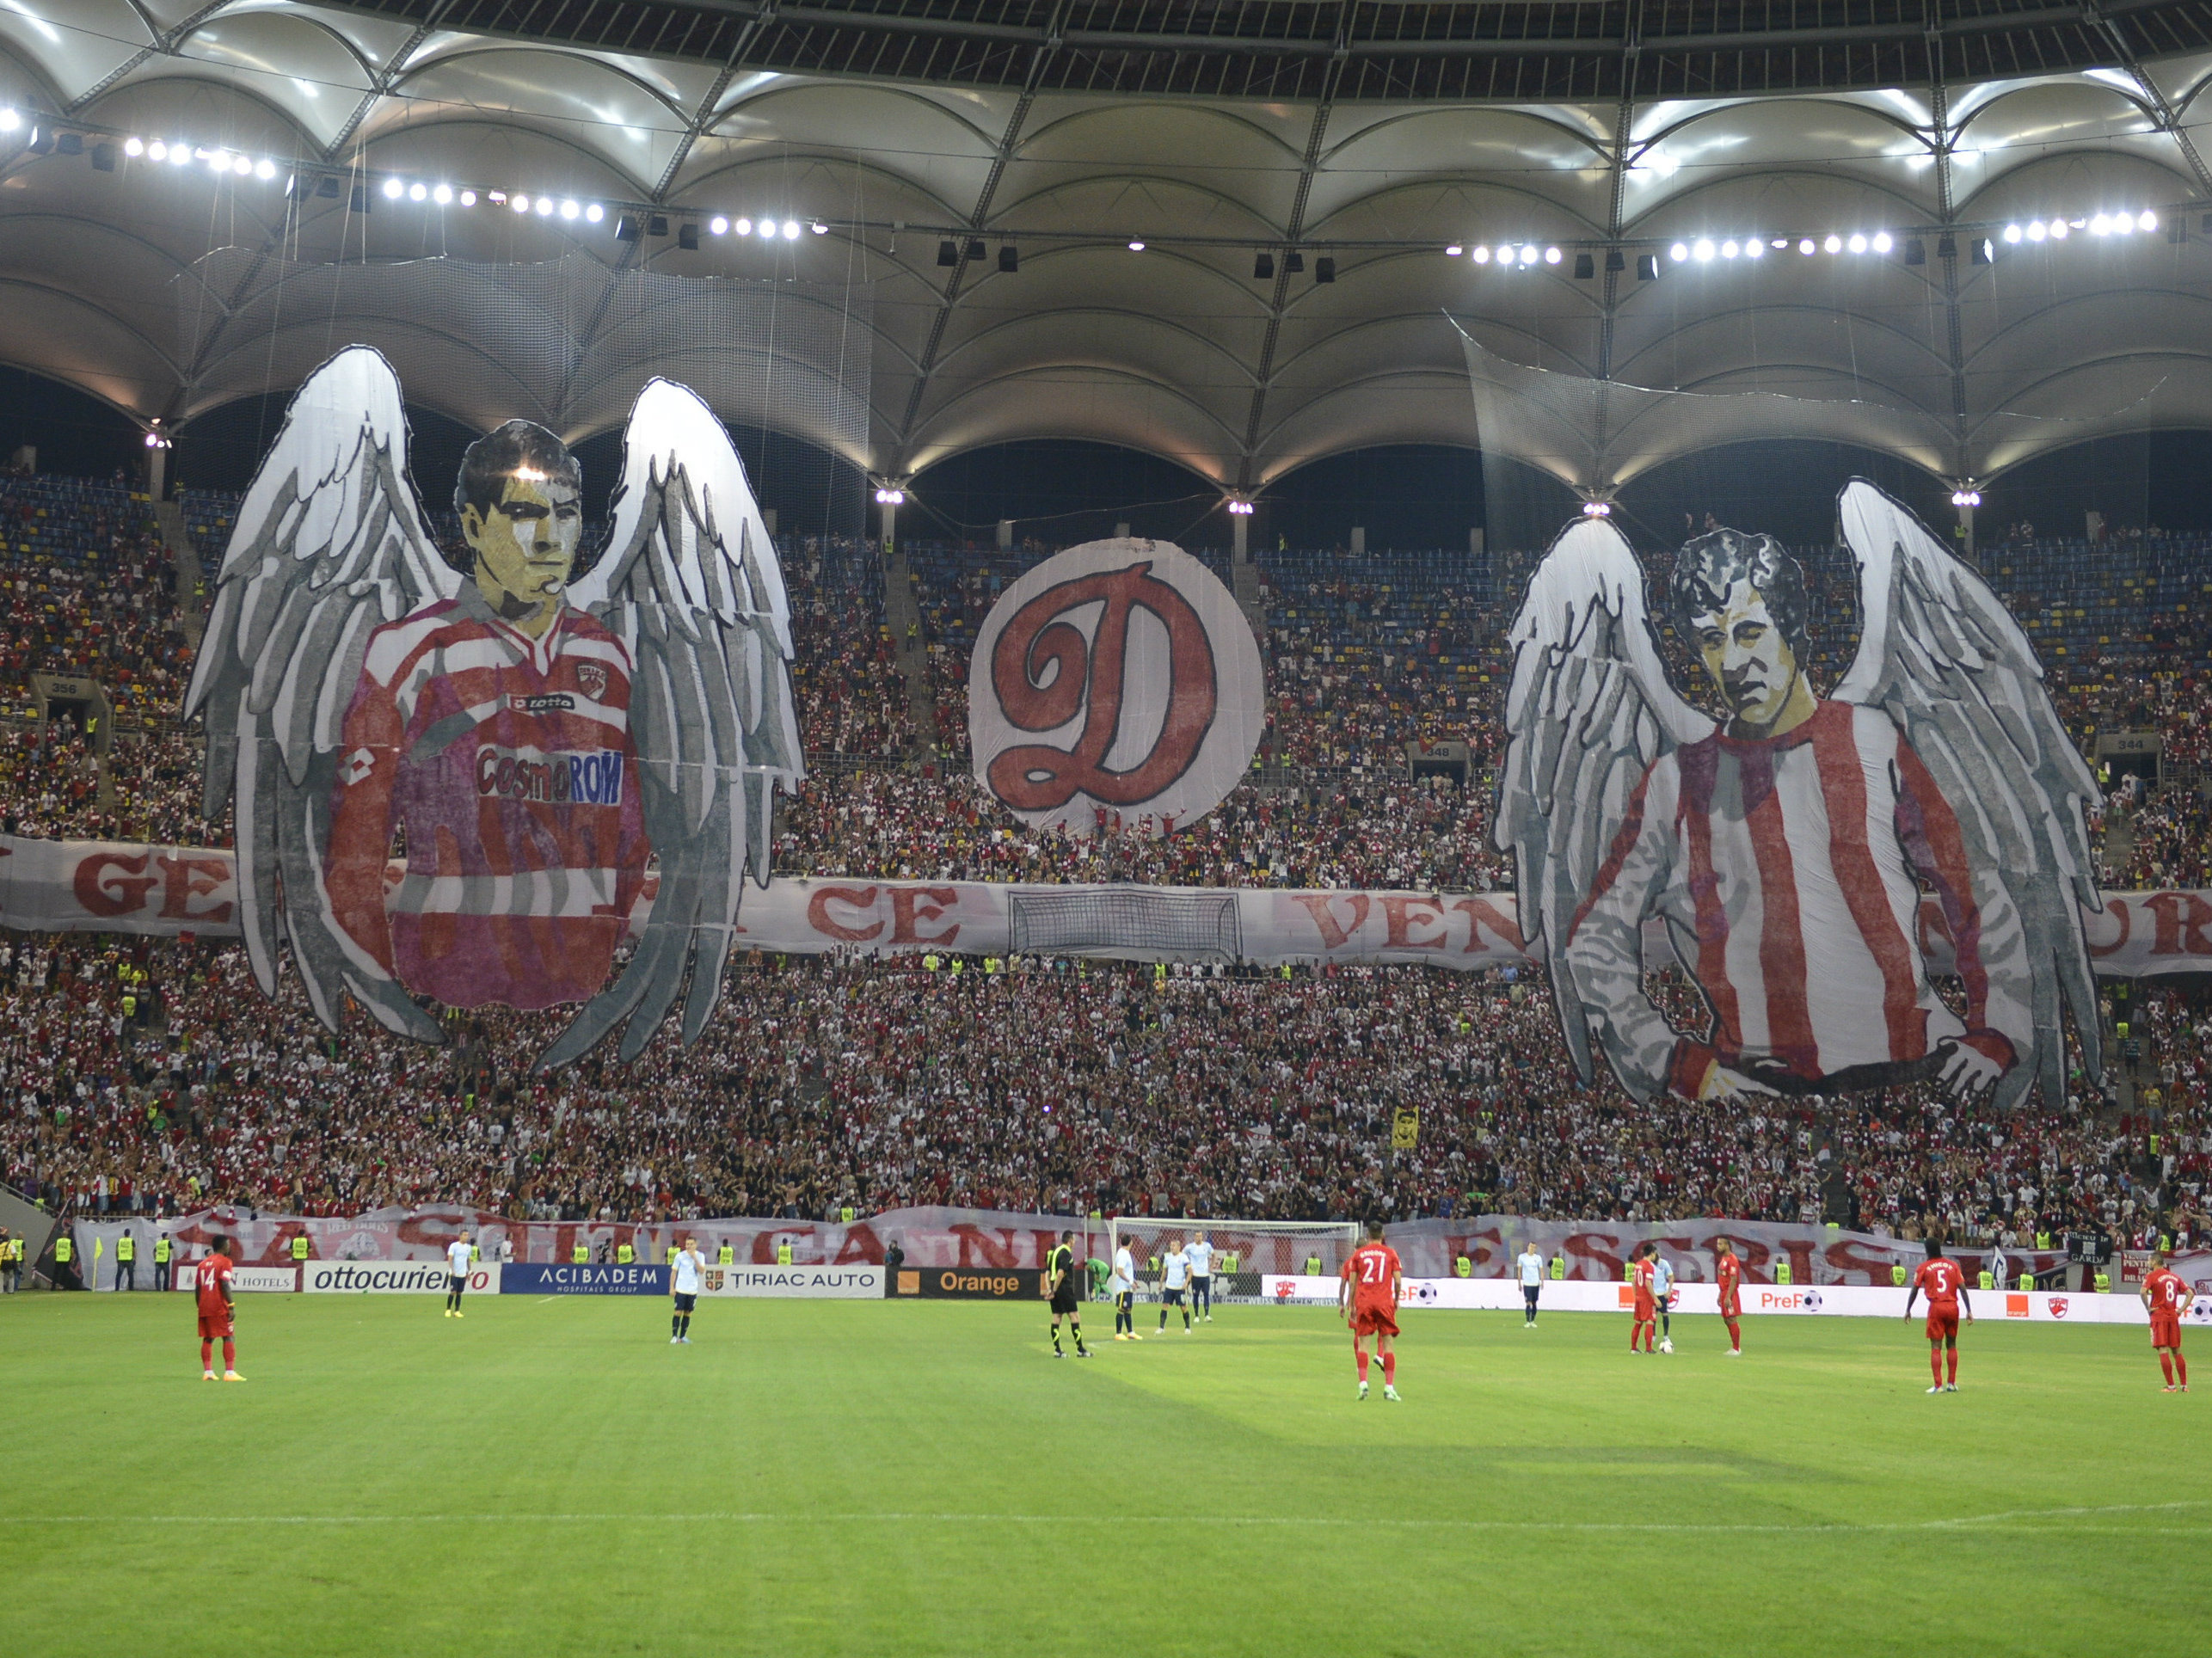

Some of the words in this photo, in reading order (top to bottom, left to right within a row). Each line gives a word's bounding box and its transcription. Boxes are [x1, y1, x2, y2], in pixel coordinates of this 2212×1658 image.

[1428, 747, 1449, 757] 348
[2118, 740, 2143, 750] 344
[539, 1268, 657, 1284] ACIBADEM
[1362, 1256, 1386, 1283] 21
[200, 1267, 216, 1292] 14
[243, 1277, 290, 1287] HOTELS
[812, 1274, 875, 1287] AUTO
[940, 1272, 1019, 1295] Orange
[1937, 1269, 1947, 1293] 5
[2166, 1280, 2175, 1302] 8
